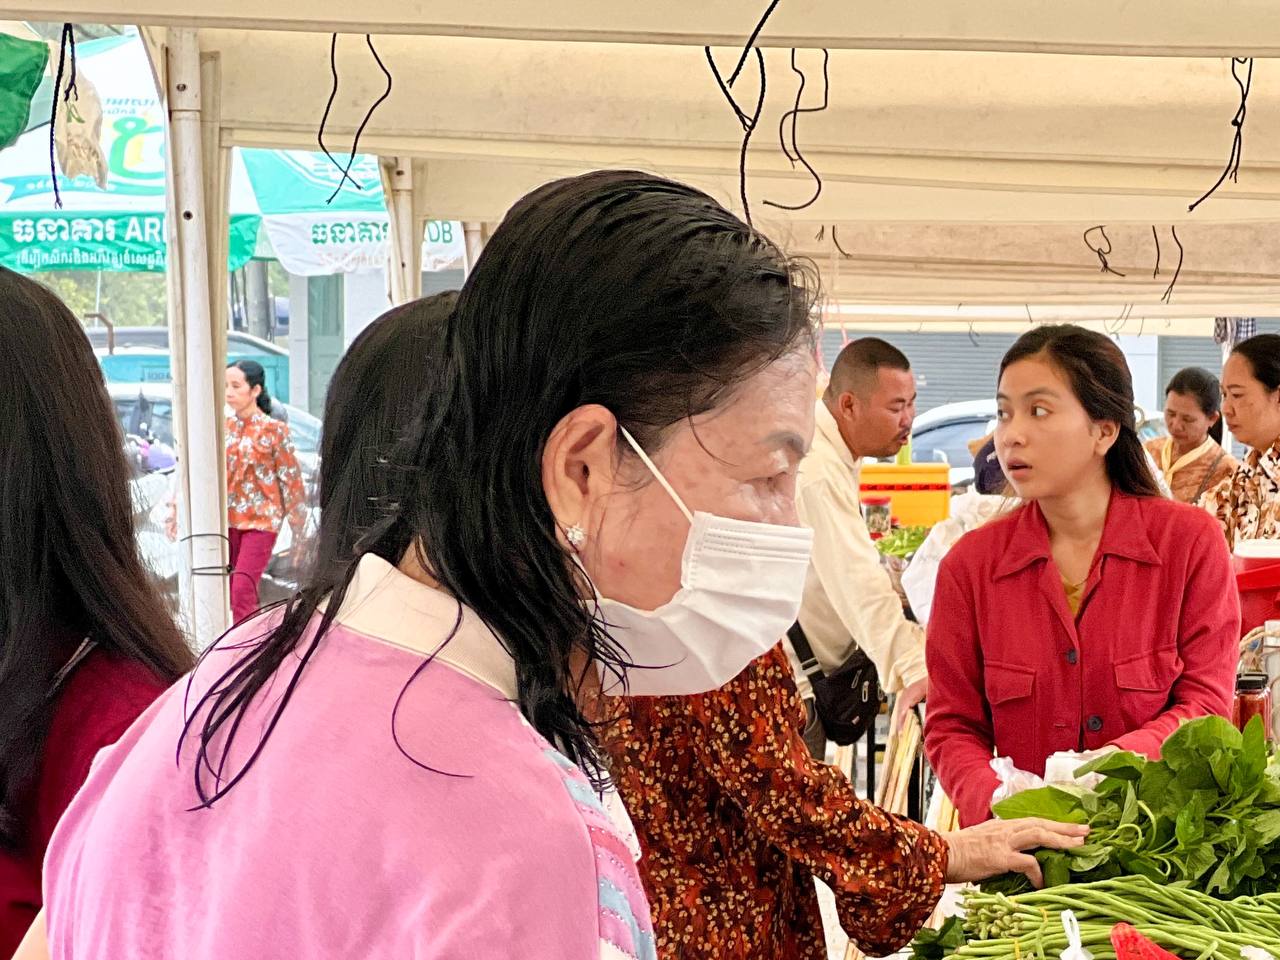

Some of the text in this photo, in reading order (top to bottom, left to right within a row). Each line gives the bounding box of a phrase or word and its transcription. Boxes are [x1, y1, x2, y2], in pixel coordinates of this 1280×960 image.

[12, 217, 167, 243] ធនាគារ AR
[426, 219, 454, 243] DB
